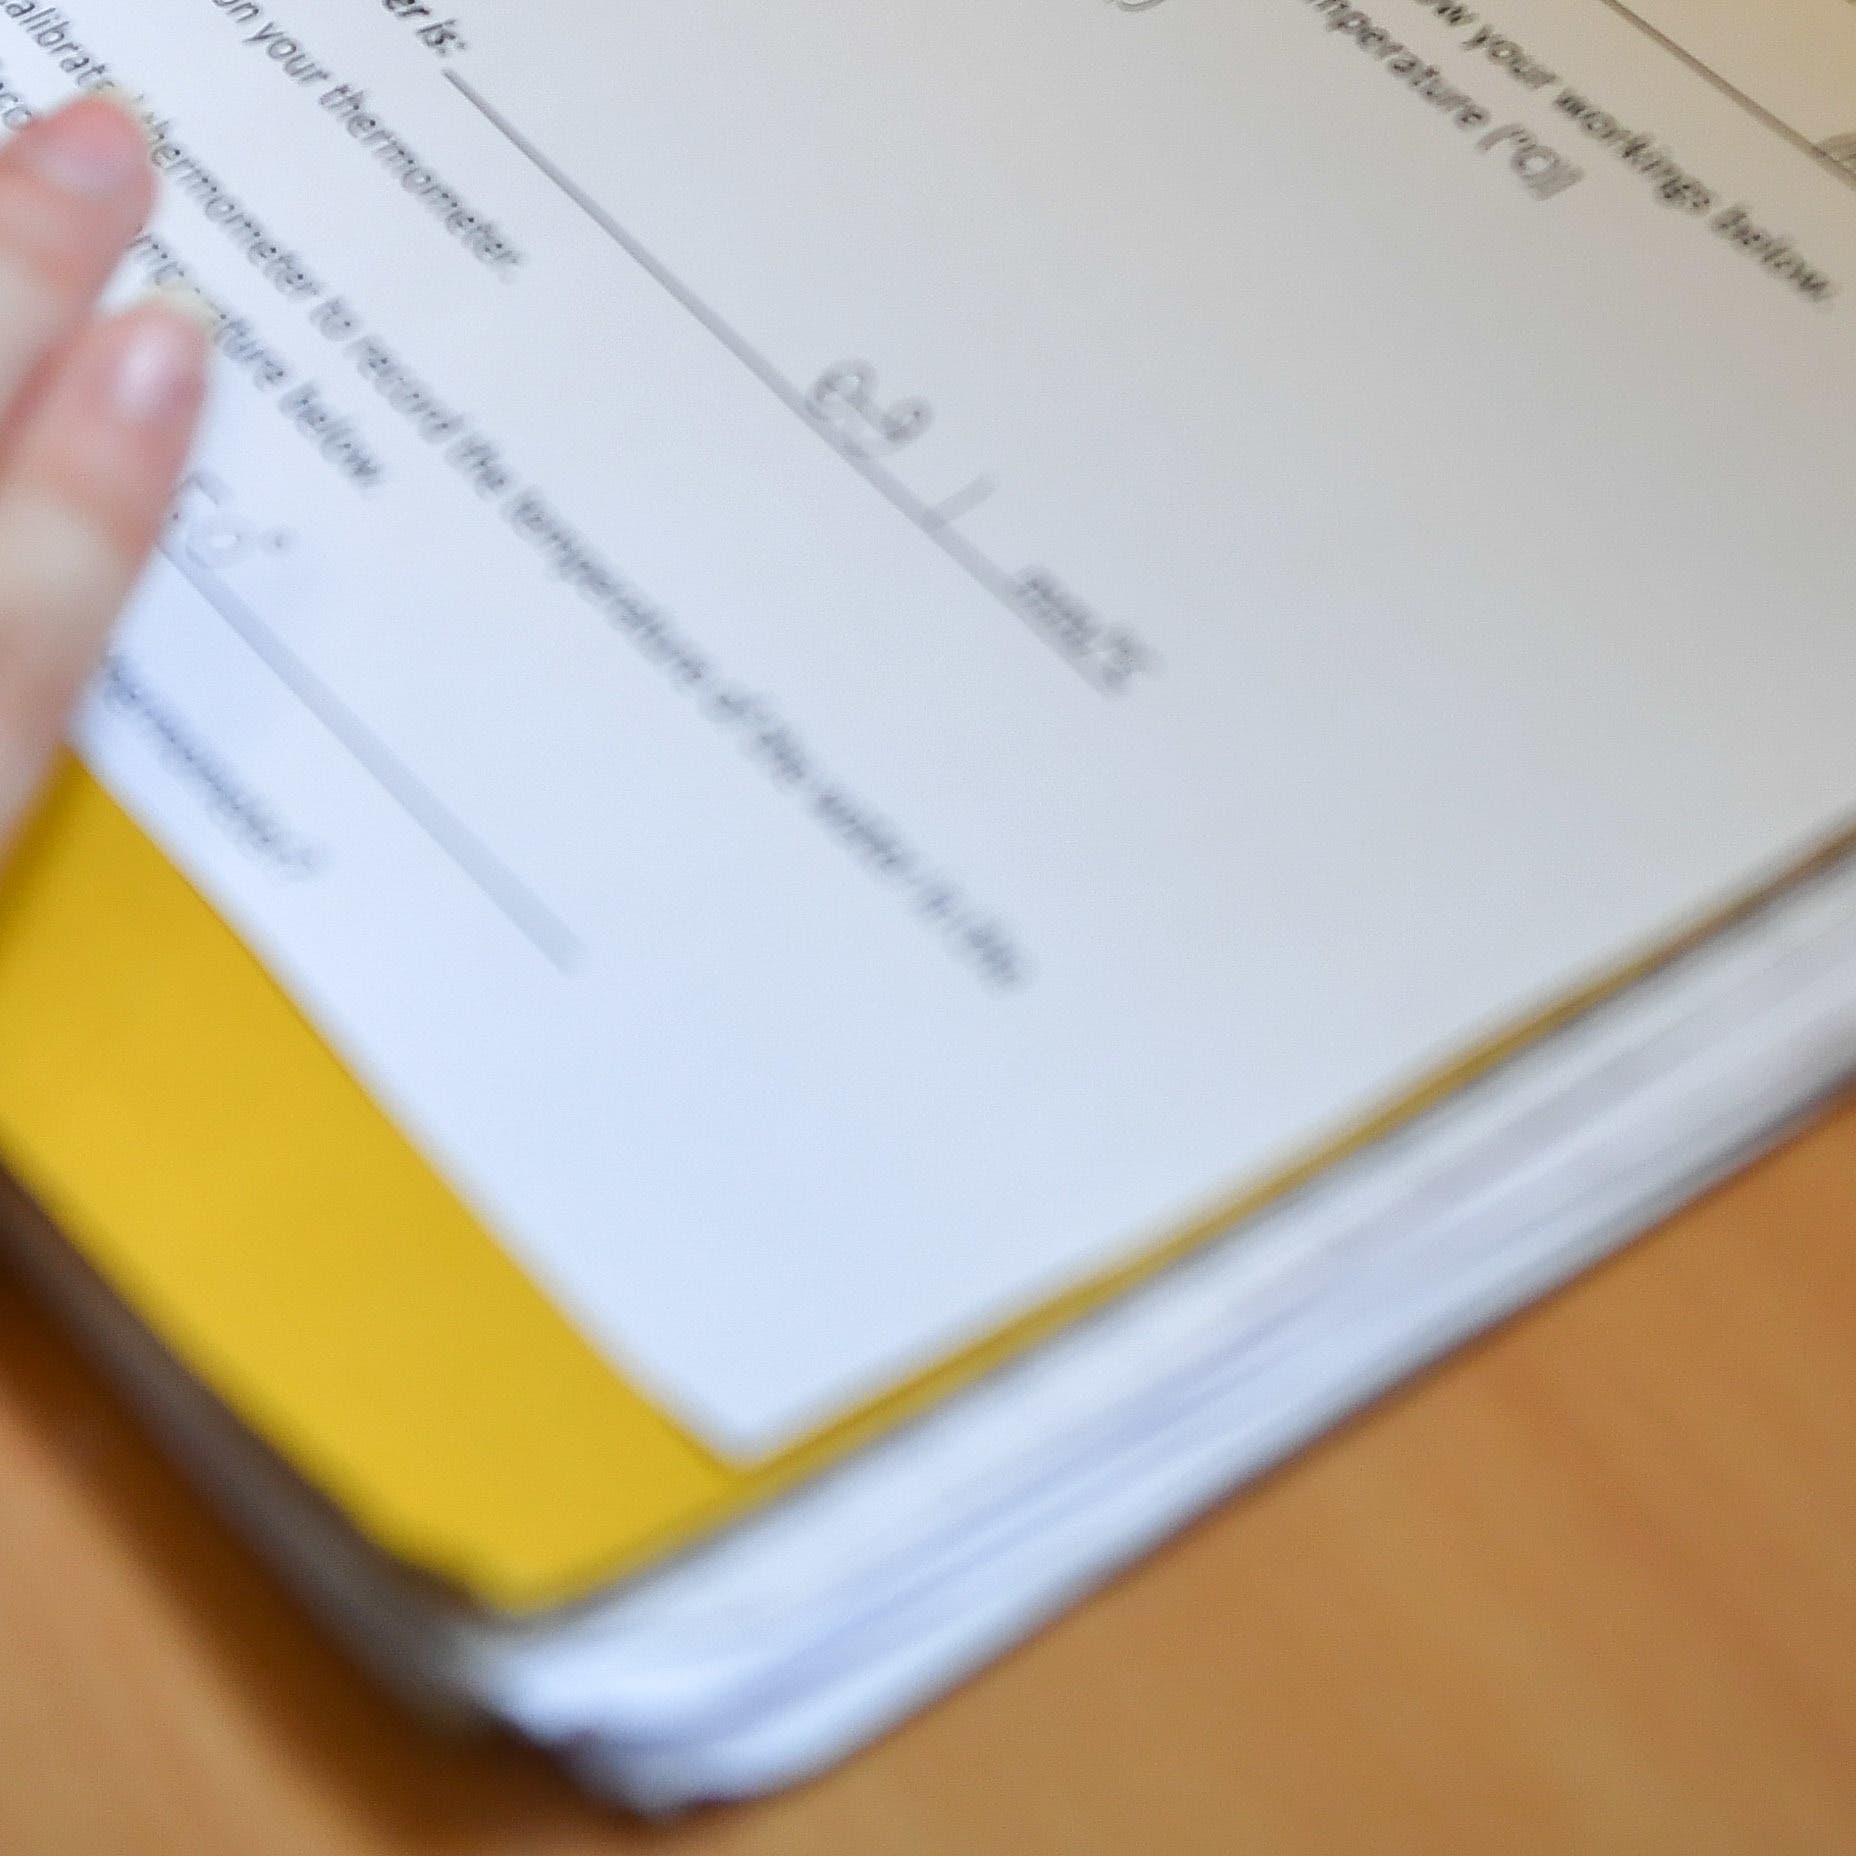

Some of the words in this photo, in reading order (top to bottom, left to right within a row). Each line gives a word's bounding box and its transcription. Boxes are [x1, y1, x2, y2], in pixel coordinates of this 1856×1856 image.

[241, 22, 332, 86] your
[317, 82, 524, 283] thermometer.
[414, 20, 465, 57] is:
[1461, 24, 1559, 88] your
[1552, 88, 1711, 212] workings
[1711, 205, 1830, 301] below.
